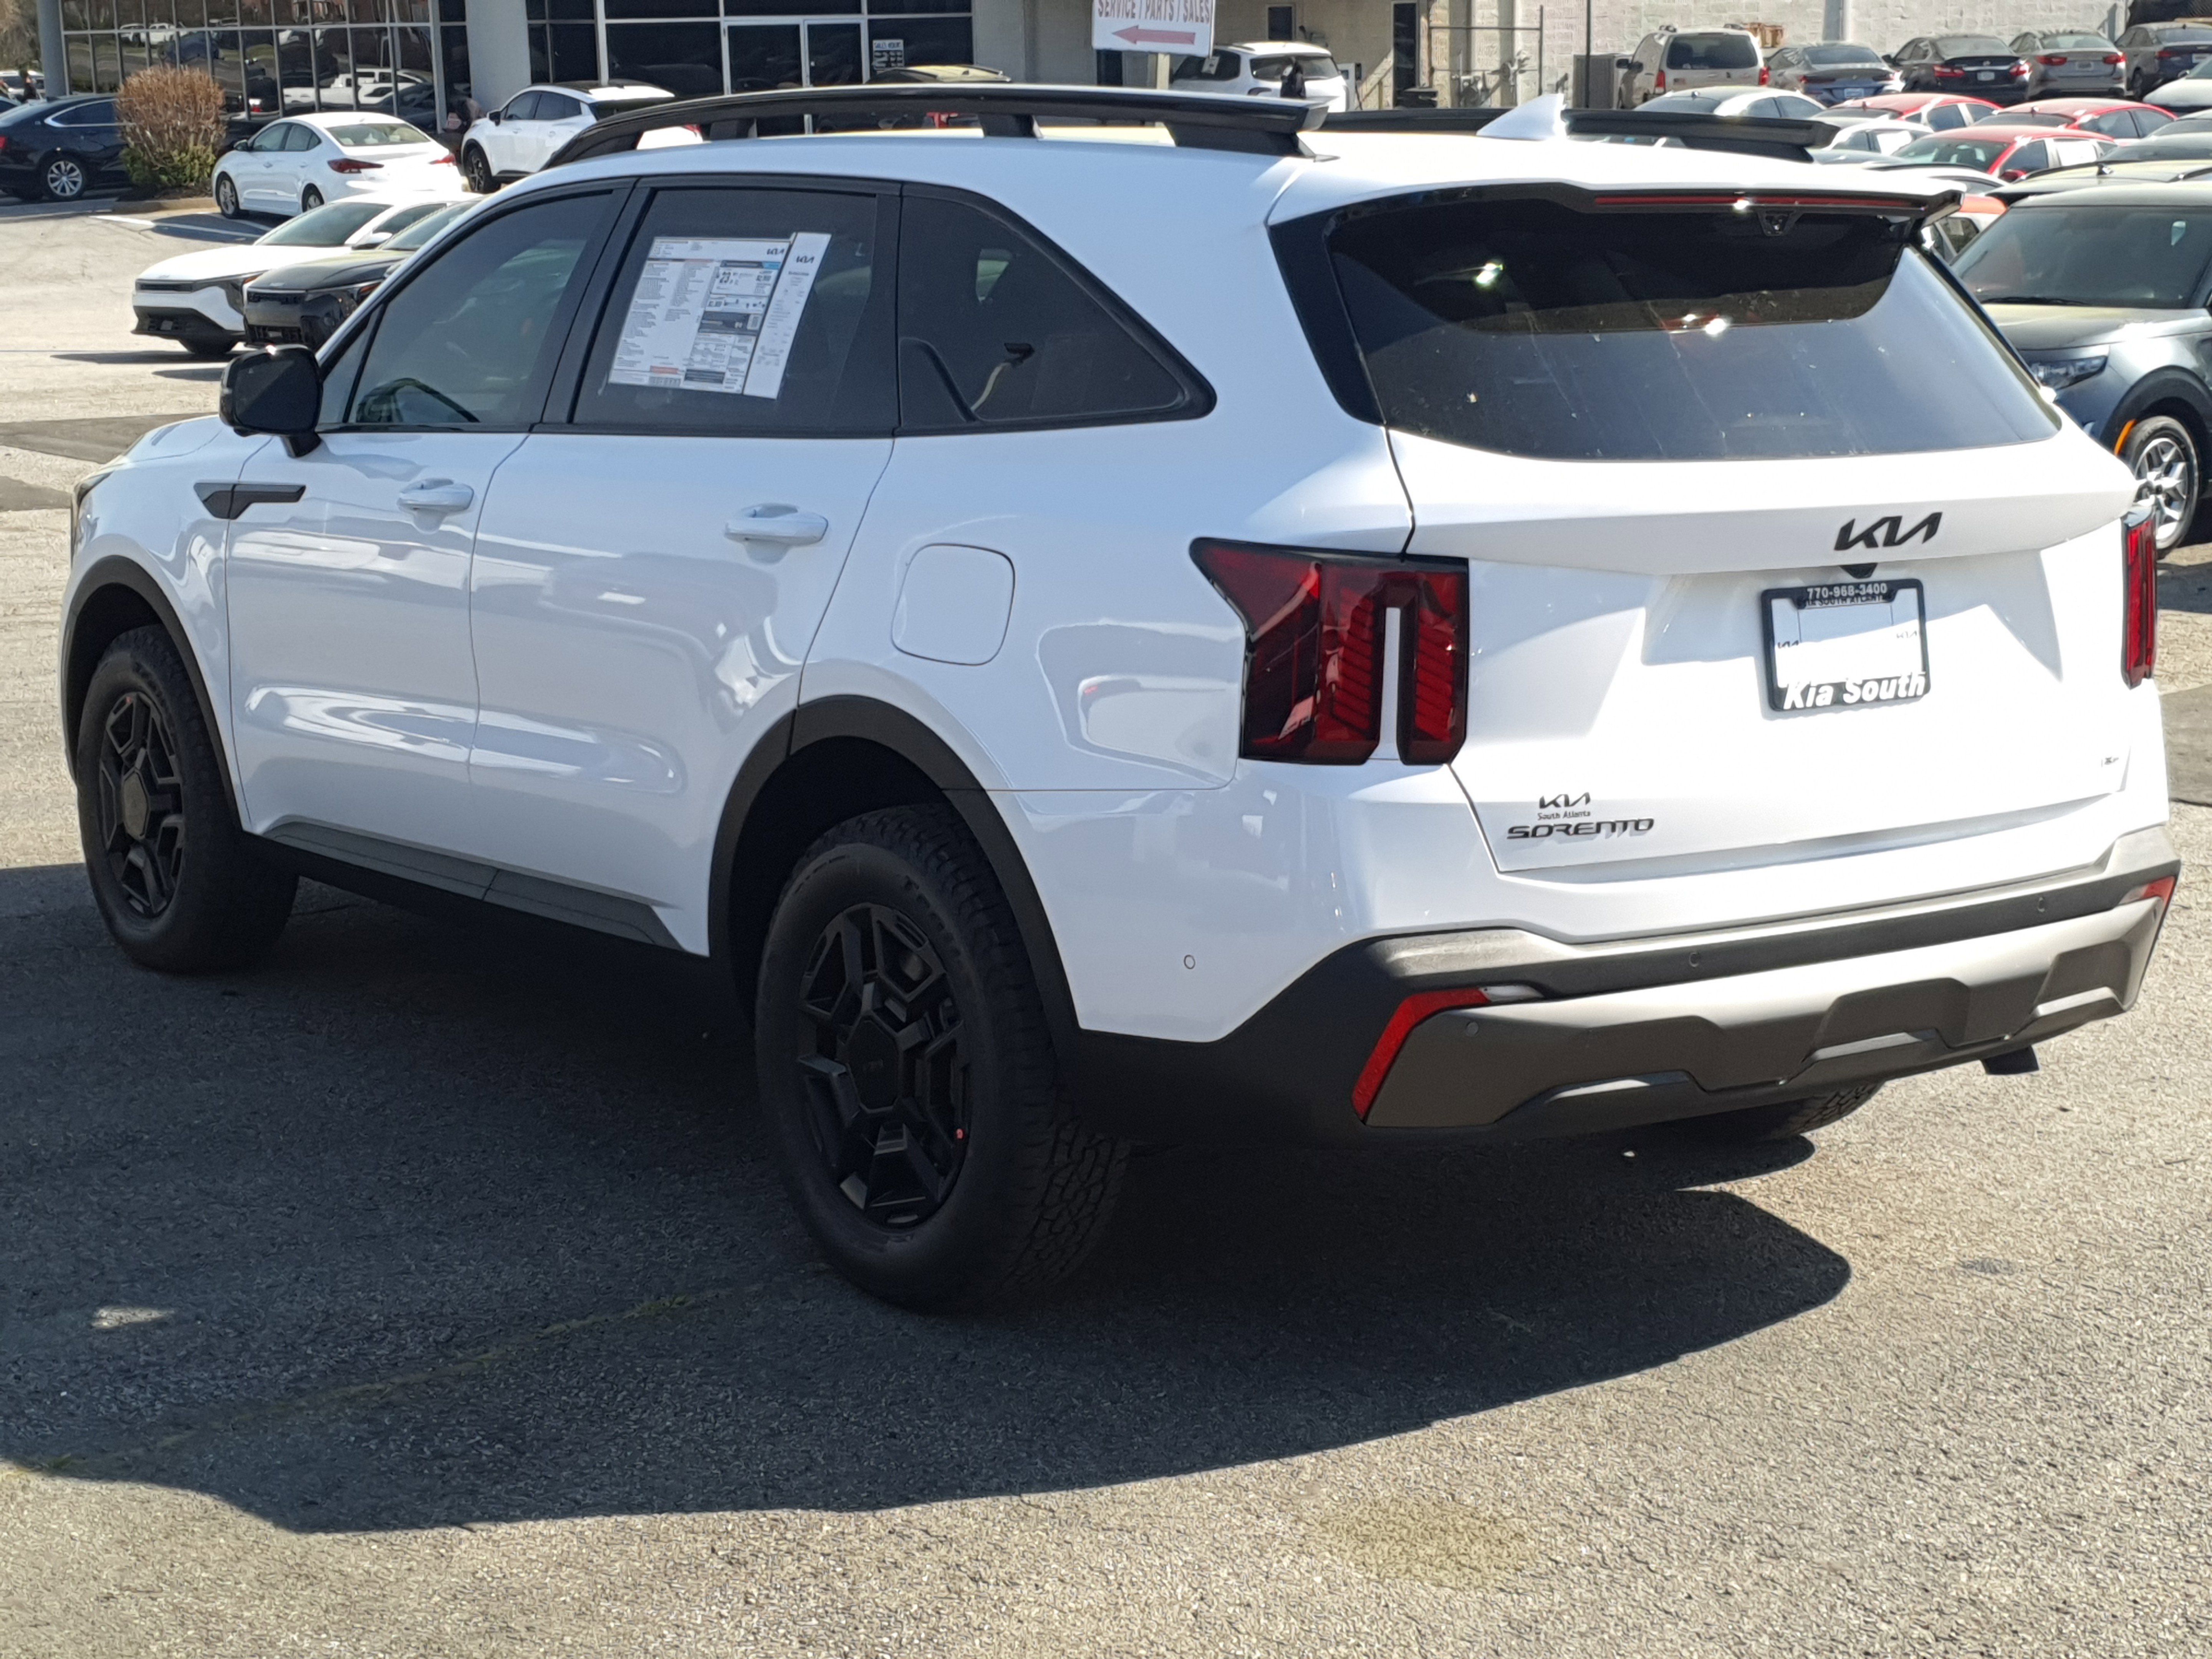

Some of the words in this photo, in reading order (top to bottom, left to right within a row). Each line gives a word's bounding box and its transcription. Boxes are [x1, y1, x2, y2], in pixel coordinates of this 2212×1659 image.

[1098, 0, 1136, 18] SERVICE
[1145, 0, 1174, 21] PARTS
[1183, 0, 1210, 23] SALES
[1834, 512, 1942, 551] KIA
[1807, 583, 1887, 599] 770-968-3400
[1783, 681, 1834, 710] Kia
[1843, 671, 1926, 704] South
[1539, 792, 1591, 809] KIA
[1537, 811, 1561, 821] South
[1562, 810, 1591, 819] Atlanta
[1507, 818, 1654, 839] SORENTO
